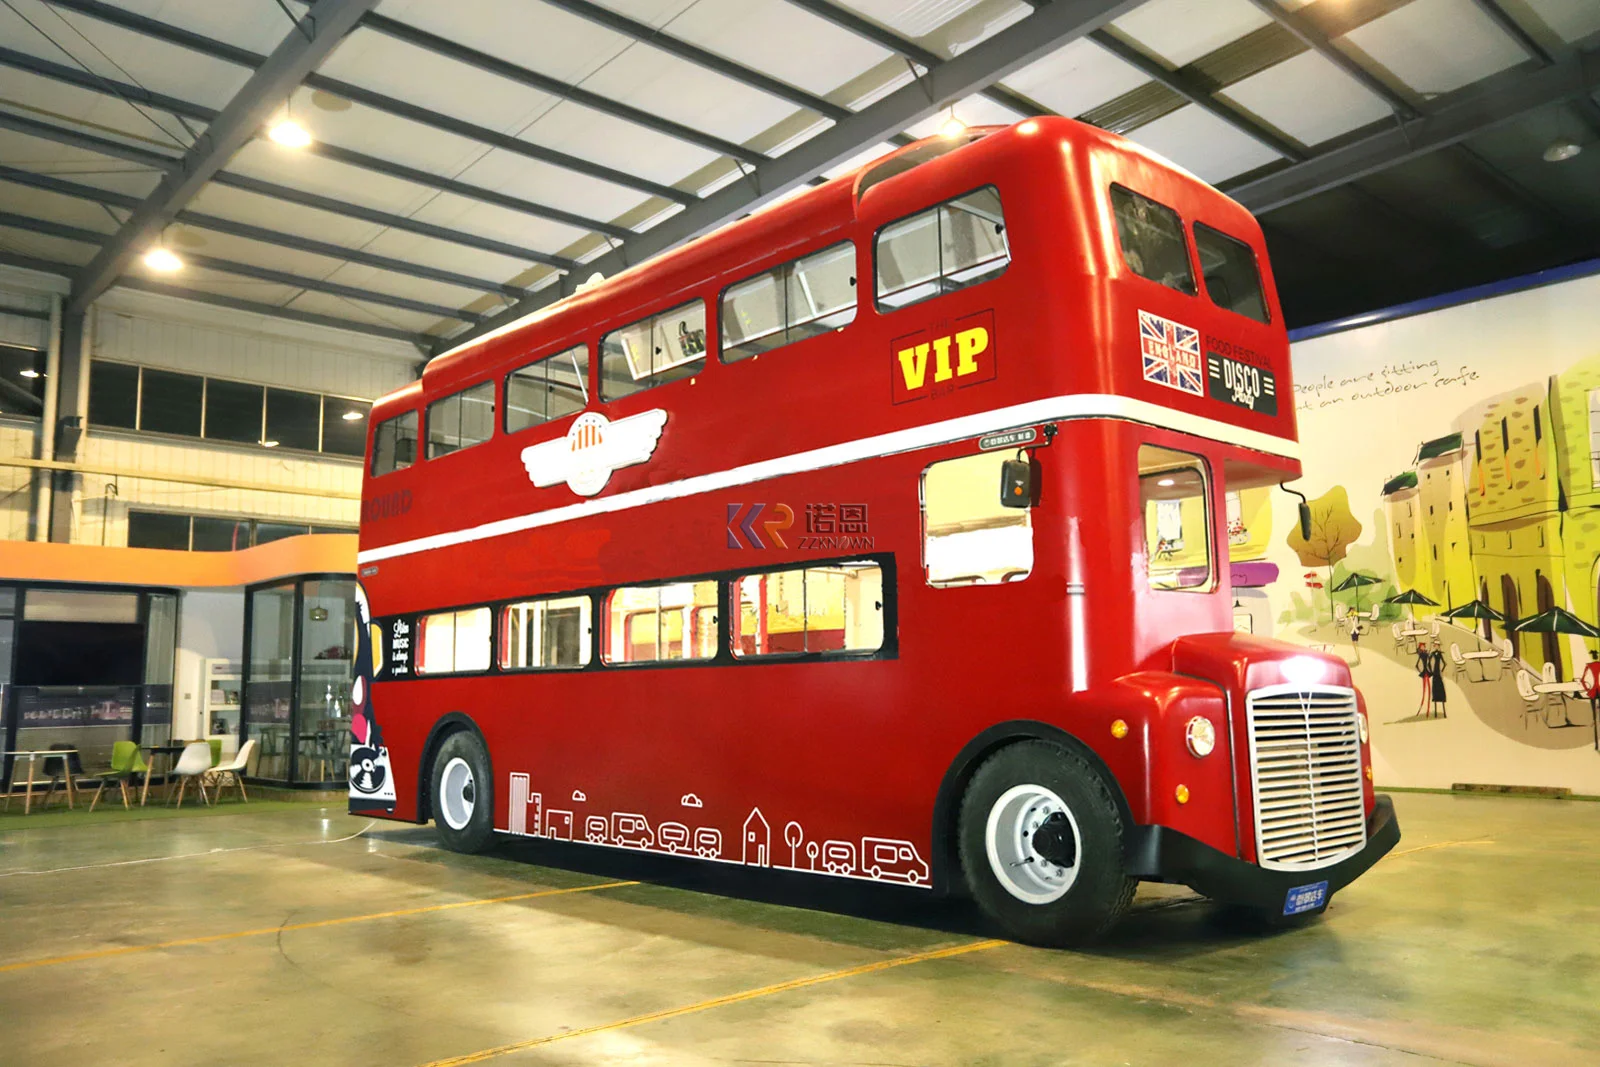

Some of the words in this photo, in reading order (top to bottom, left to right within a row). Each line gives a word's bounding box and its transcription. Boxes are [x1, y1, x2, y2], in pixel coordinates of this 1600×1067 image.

[898, 326, 989, 391] VIP
[1148, 340, 1196, 369] ENGLAND
[1206, 336, 1231, 356] FOOD
[1234, 345, 1275, 370] FESTIVAL
[1223, 359, 1260, 397] DISCO
[1340, 373, 1374, 386] are
[1381, 360, 1440, 377] sitting
[1320, 398, 1344, 408] an
[1351, 381, 1428, 400] outdoor
